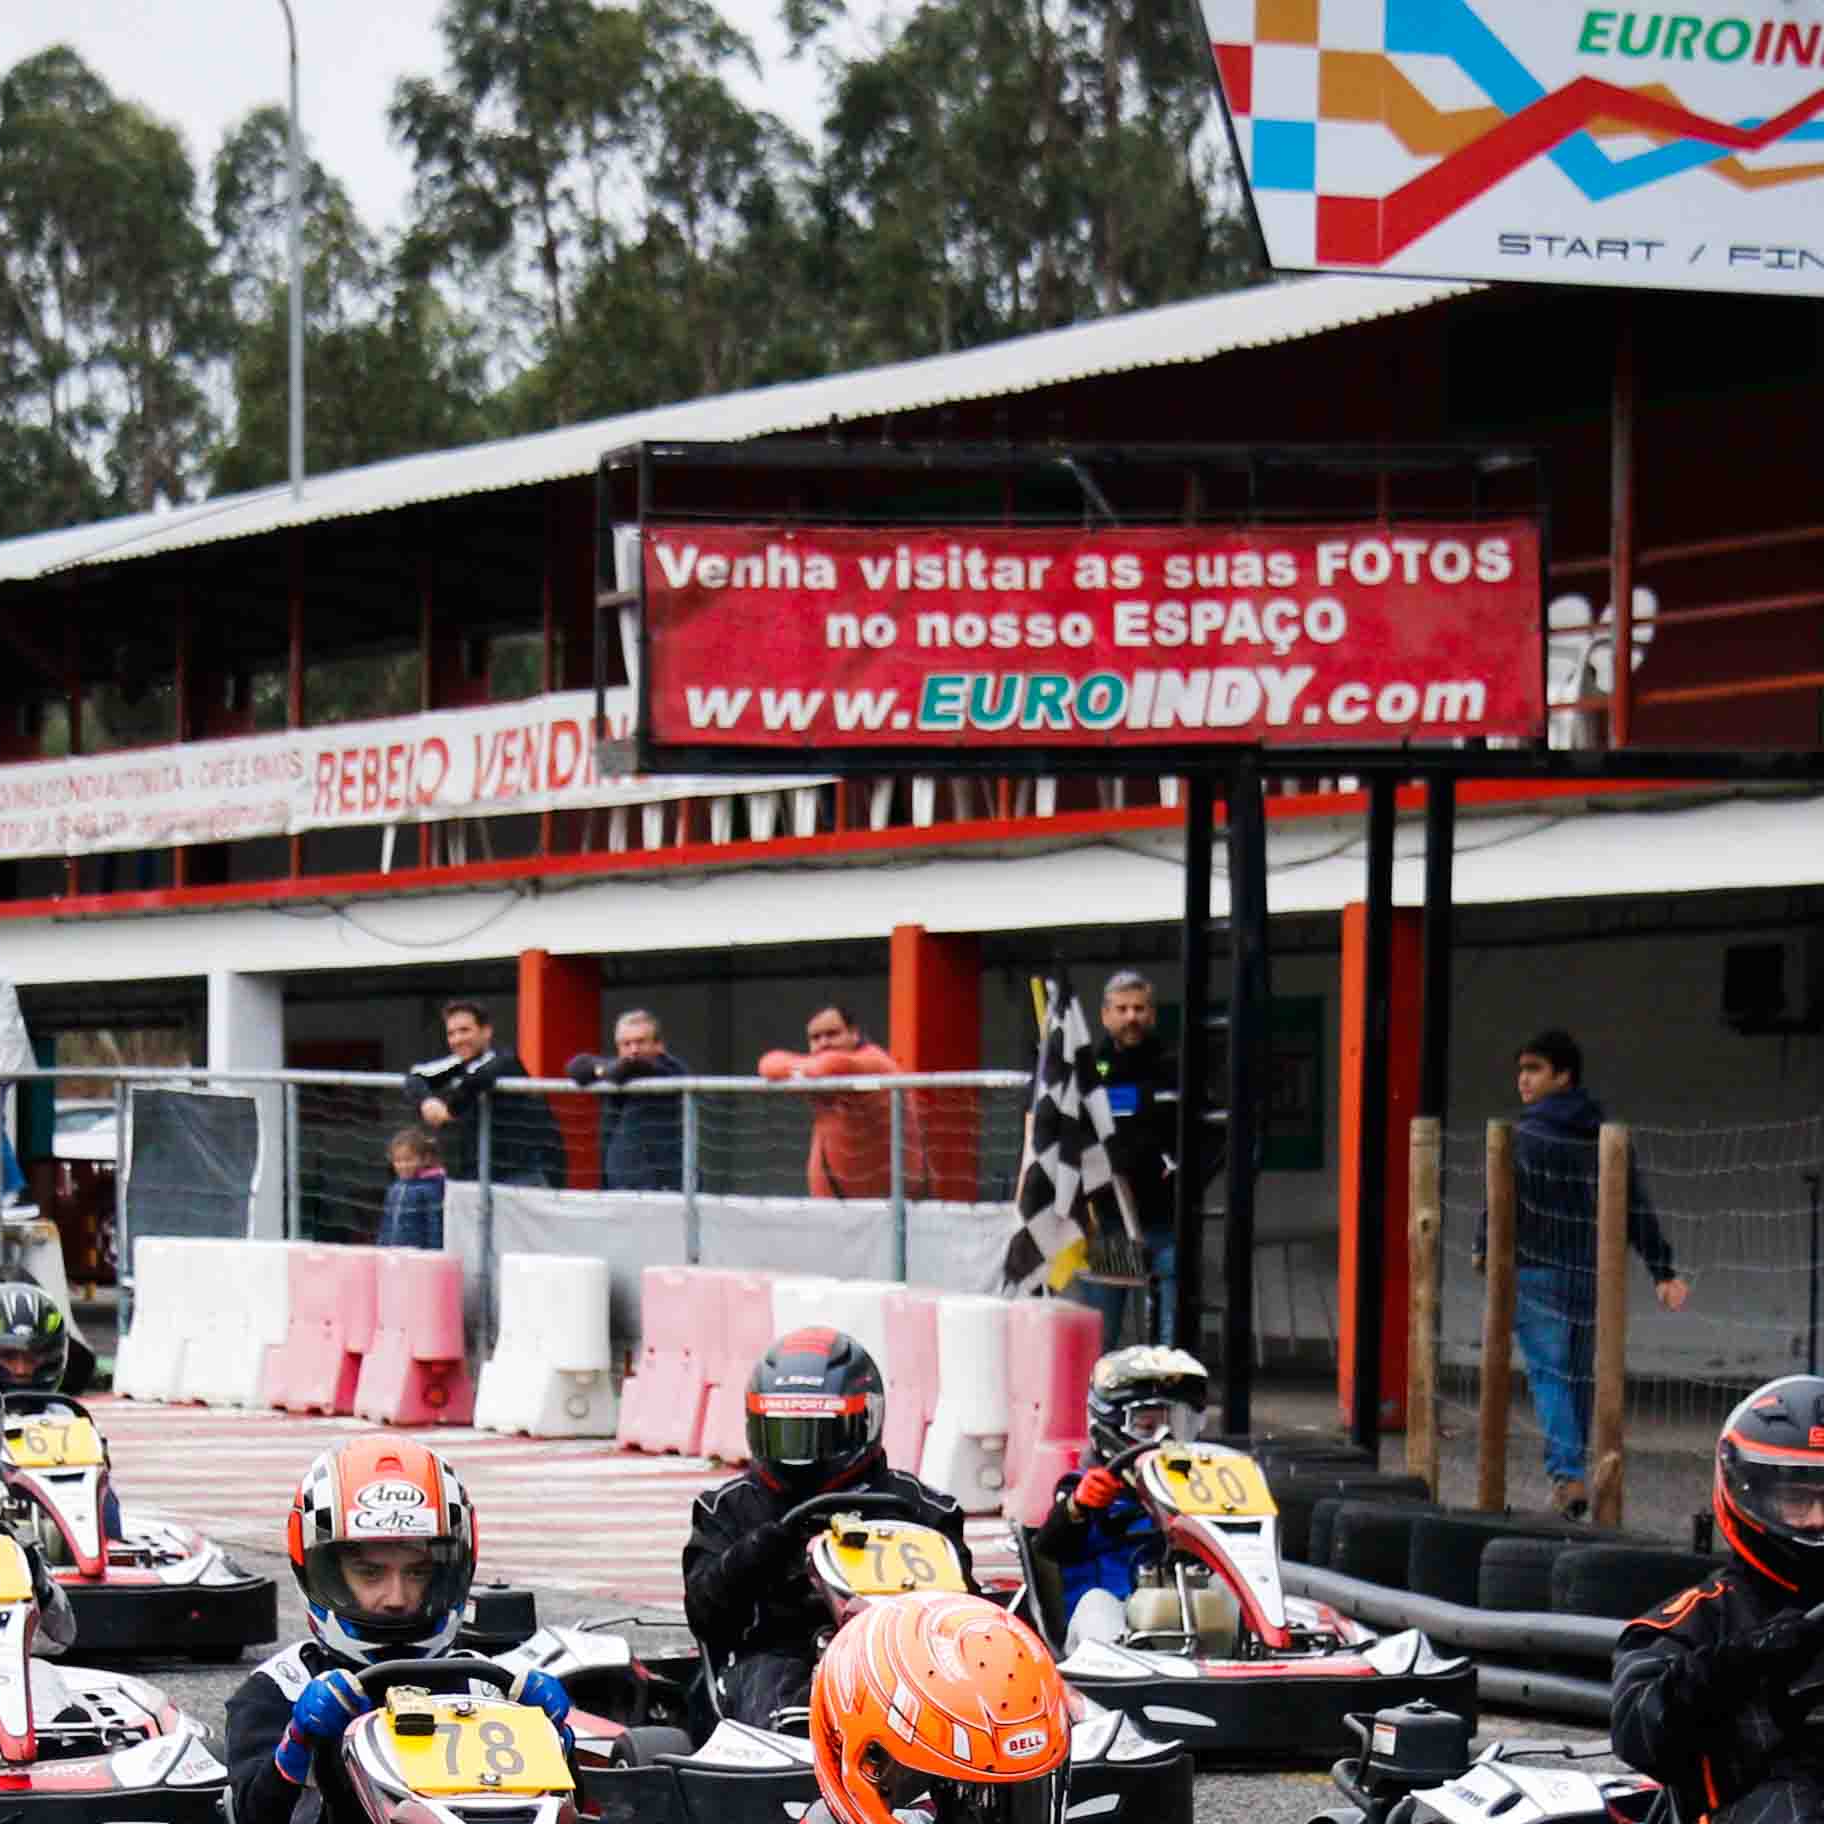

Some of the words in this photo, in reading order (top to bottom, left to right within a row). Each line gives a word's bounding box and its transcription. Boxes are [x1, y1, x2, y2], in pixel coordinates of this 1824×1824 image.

[1497, 232, 1664, 263] START
[656, 545, 836, 593] Venha
[861, 546, 1049, 592] visitar
[1074, 554, 1144, 592] as
[1163, 552, 1297, 589] suas
[1316, 538, 1512, 587] FOTOS
[826, 608, 896, 649] no
[917, 607, 1092, 648] nosso
[1114, 597, 1346, 658] ESPAÇO
[685, 667, 1487, 733] www.EUROINDY.com
[312, 737, 451, 817] REBELO
[863, 1541, 937, 1584] 76
[434, 1720, 525, 1776] 78
[1008, 1734, 1043, 1752] BELL
